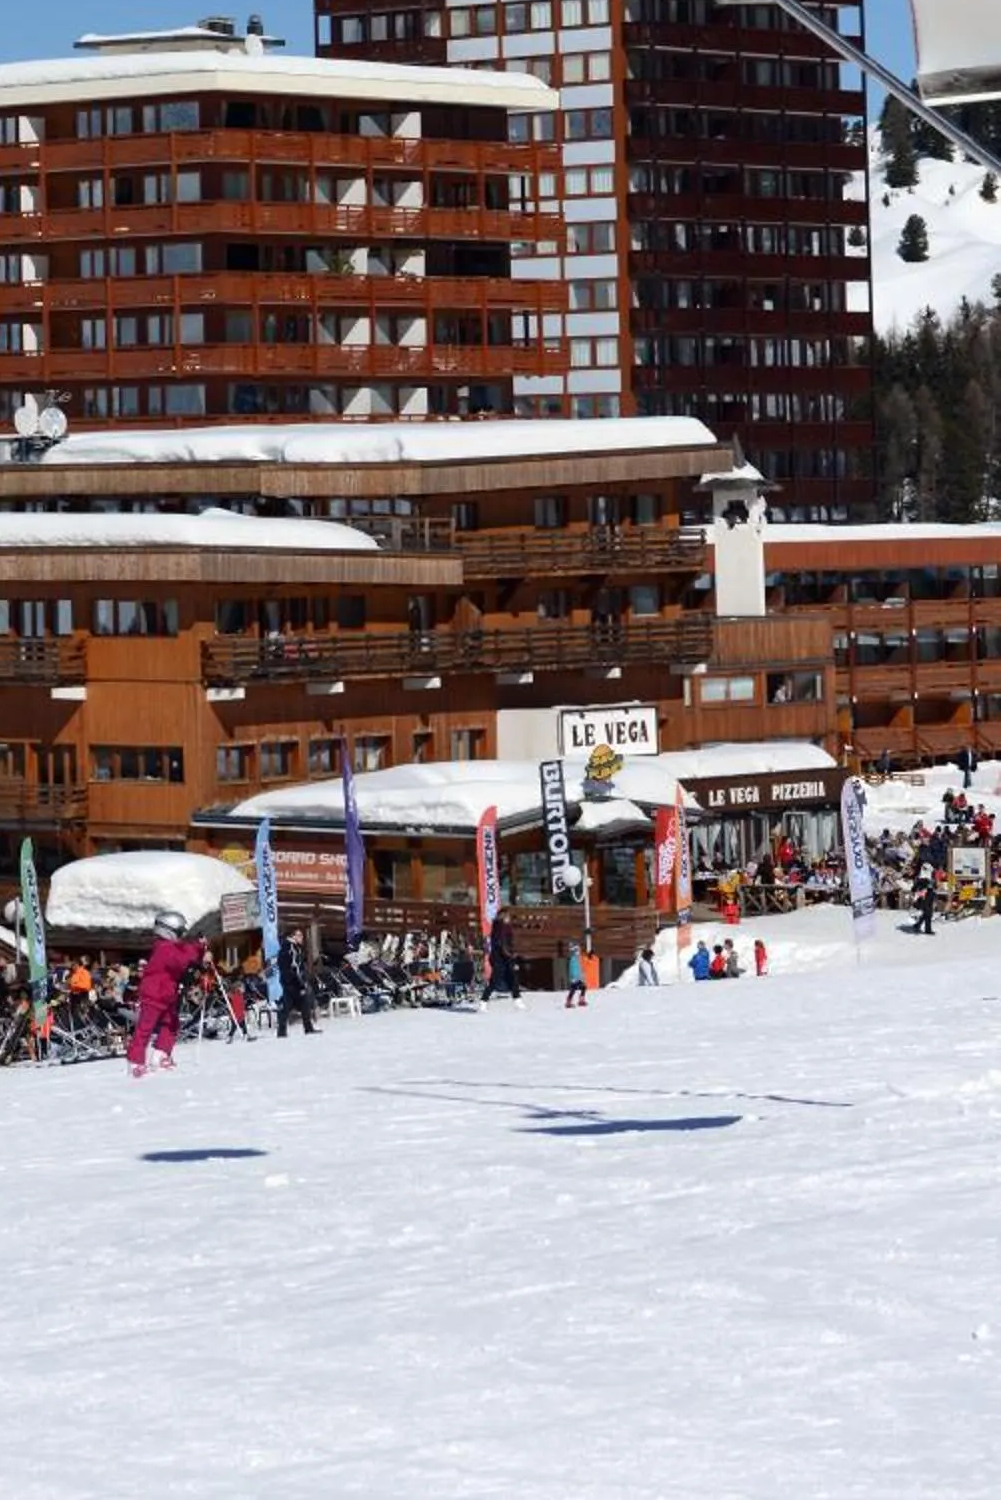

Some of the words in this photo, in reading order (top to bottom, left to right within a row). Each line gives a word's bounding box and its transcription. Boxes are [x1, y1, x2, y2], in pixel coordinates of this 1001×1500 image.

[572, 723, 596, 747] LE
[605, 719, 649, 745] VEGA
[708, 790, 726, 807] LE
[730, 786, 760, 804] VEGA
[771, 781, 826, 801] PIZZERIA
[272, 851, 316, 866] OARD
[319, 853, 348, 866] SHO
[483, 827, 495, 904] OXYGENE
[262, 846, 275, 923] OXYGENE
